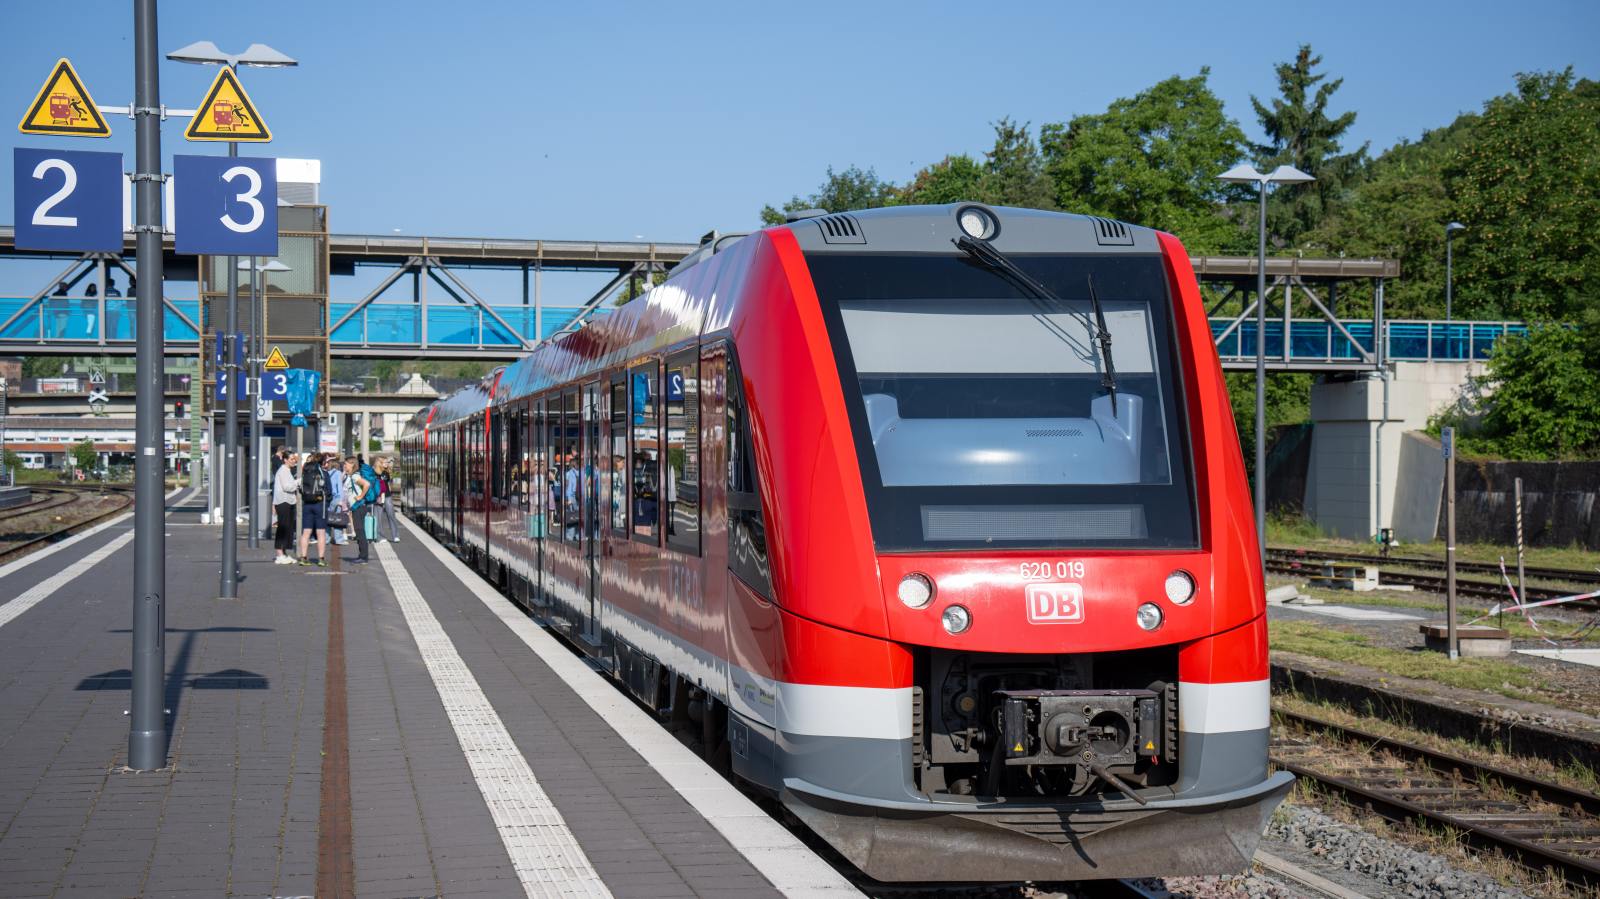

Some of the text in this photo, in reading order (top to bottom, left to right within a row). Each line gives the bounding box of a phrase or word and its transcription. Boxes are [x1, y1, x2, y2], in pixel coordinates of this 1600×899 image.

[31, 158, 78, 227] 2
[219, 166, 265, 233] 3
[273, 374, 288, 395] 3
[668, 562, 698, 609] vareo
[1020, 561, 1085, 579] 620 019
[1033, 590, 1077, 617] DB
